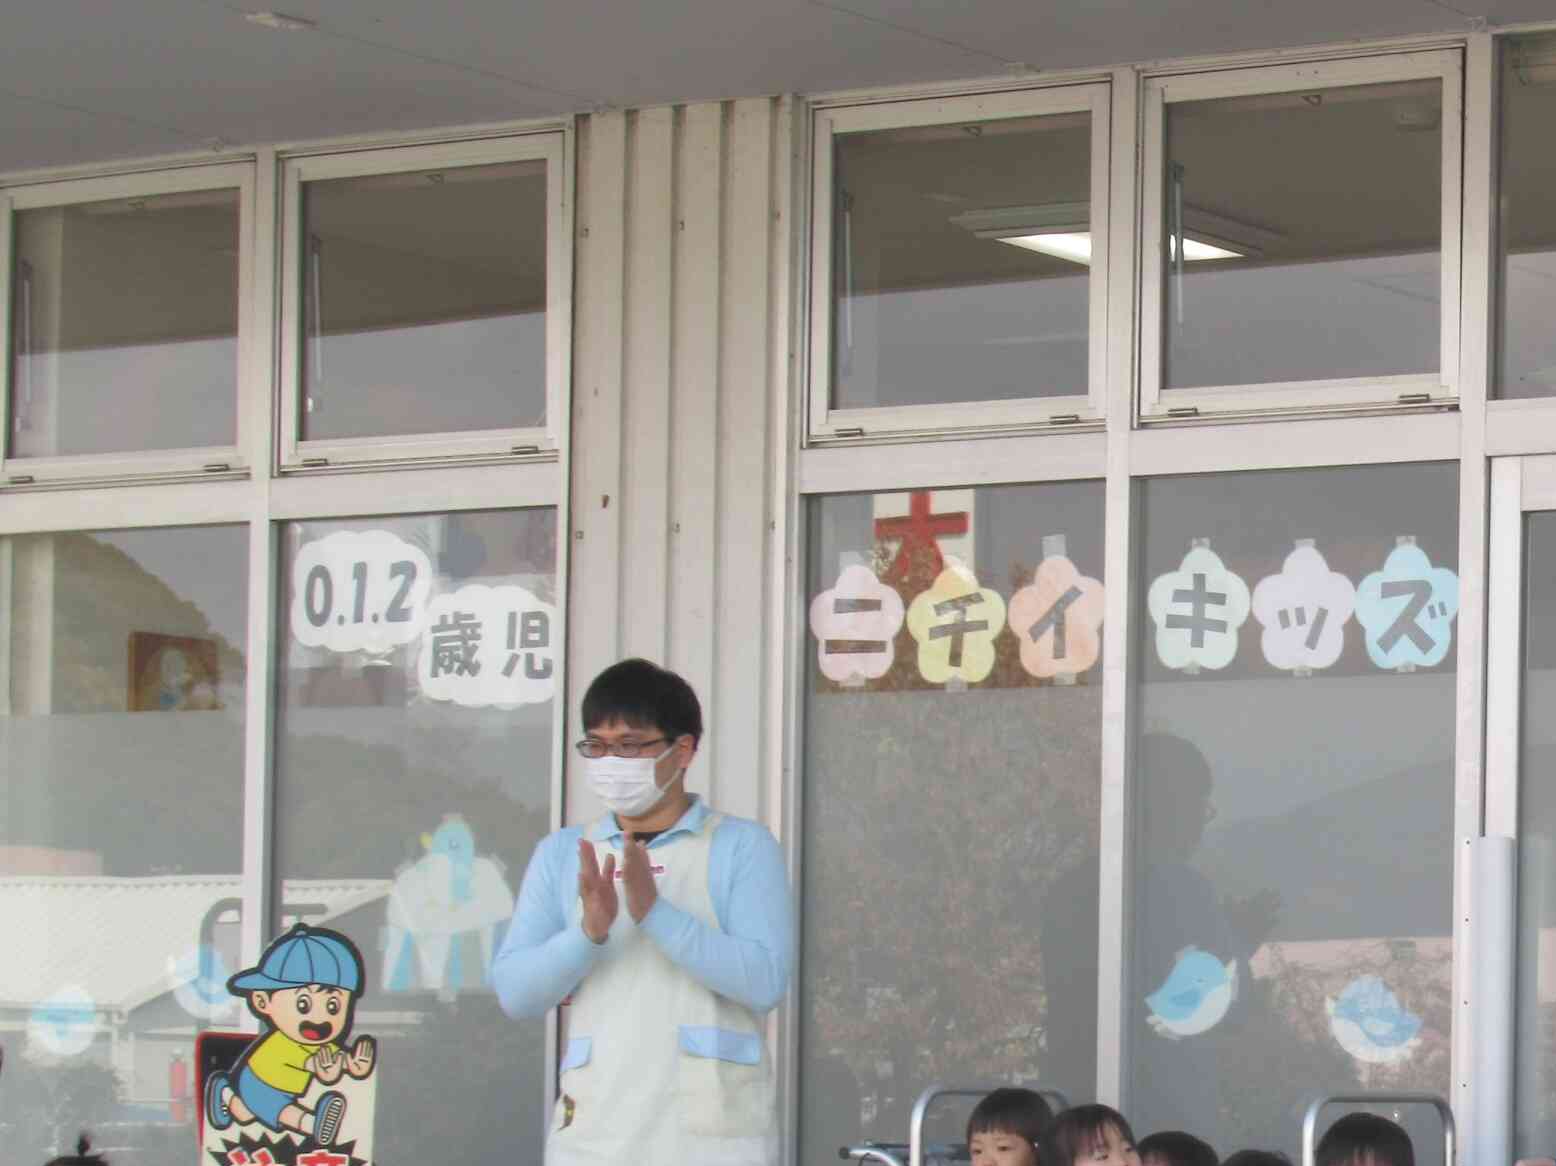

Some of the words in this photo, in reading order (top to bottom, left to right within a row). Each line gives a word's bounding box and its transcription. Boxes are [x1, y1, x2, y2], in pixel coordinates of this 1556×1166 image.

[430, 611, 552, 681] 歳児
[825, 586, 1082, 667] ニチイ
[1165, 574, 1448, 656] キッズ
